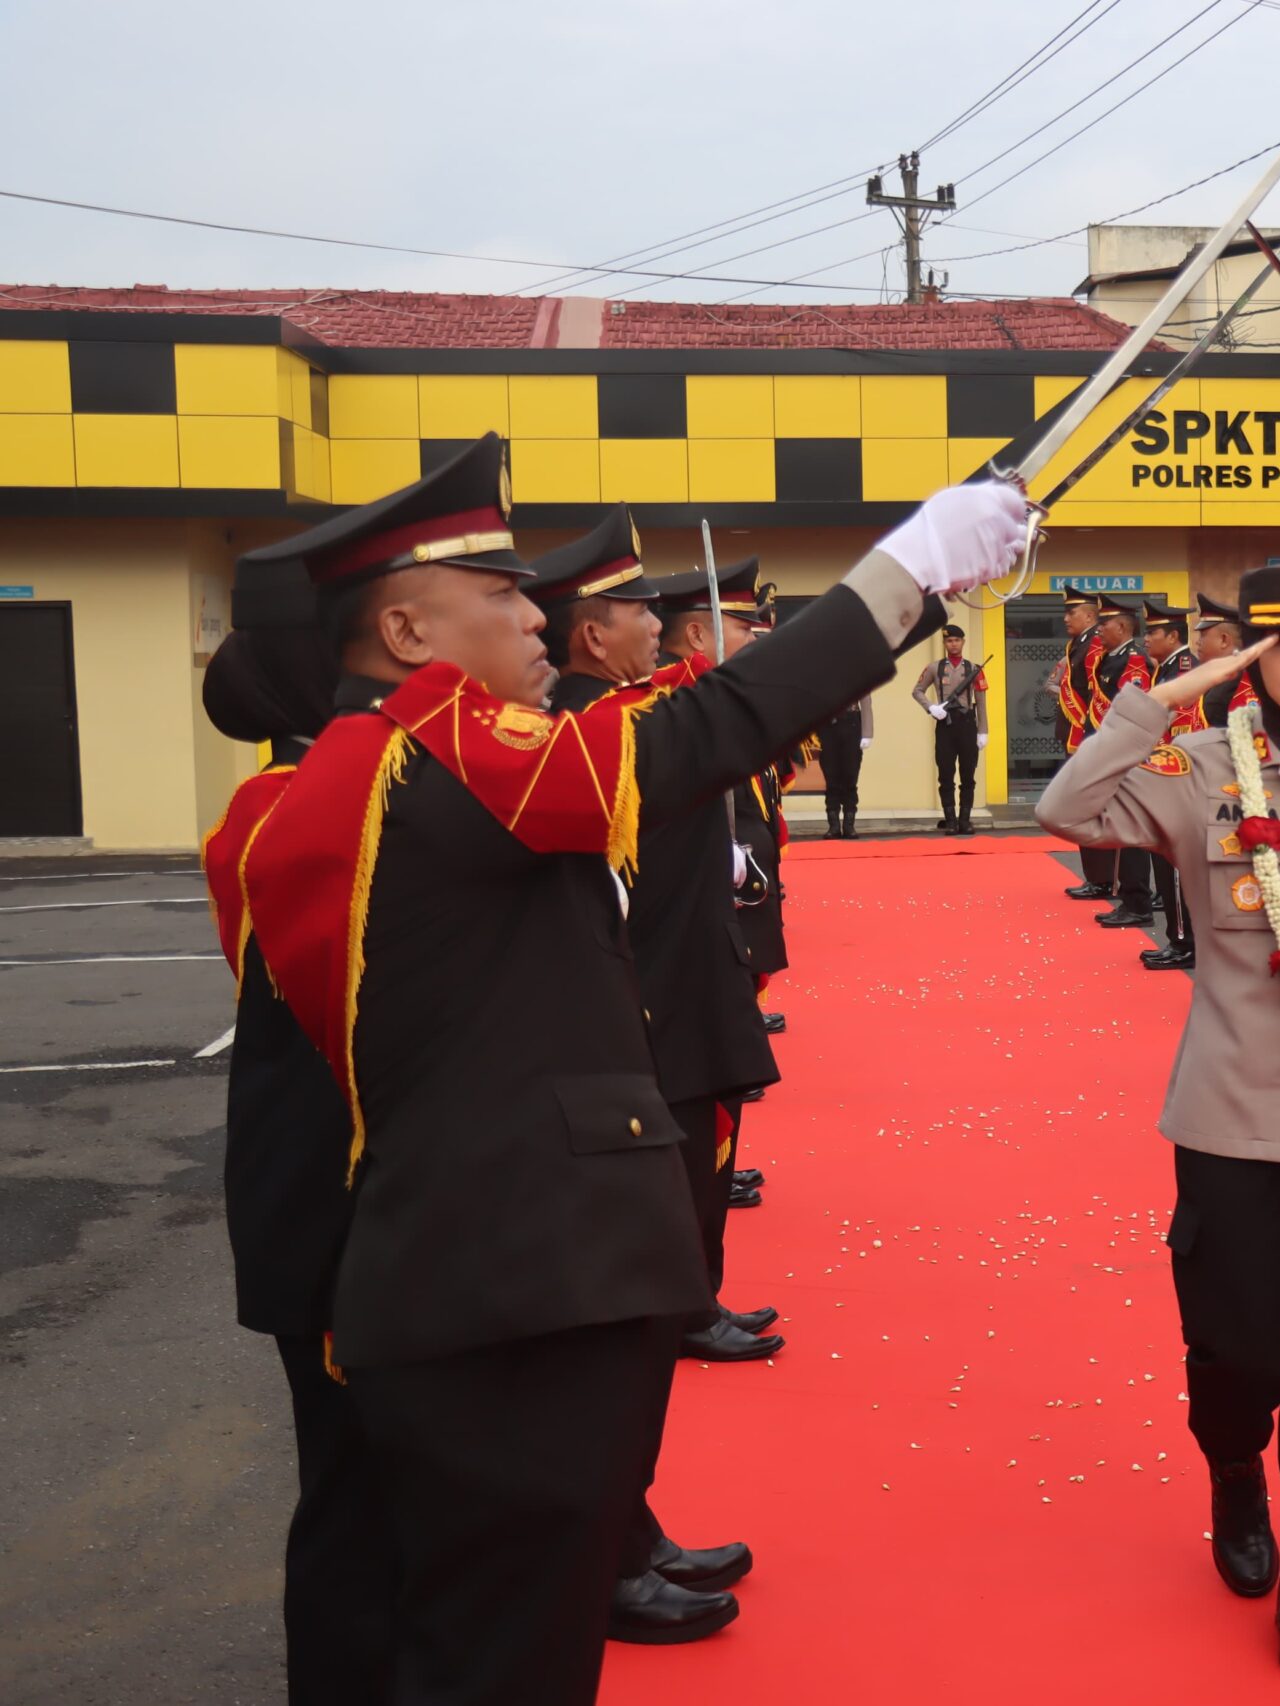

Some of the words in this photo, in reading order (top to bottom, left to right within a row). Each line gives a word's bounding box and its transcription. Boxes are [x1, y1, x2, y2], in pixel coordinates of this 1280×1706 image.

[1131, 464, 1253, 489] POLRES
[1055, 577, 1137, 590] KELUAR
[1216, 803, 1280, 822] ANA
